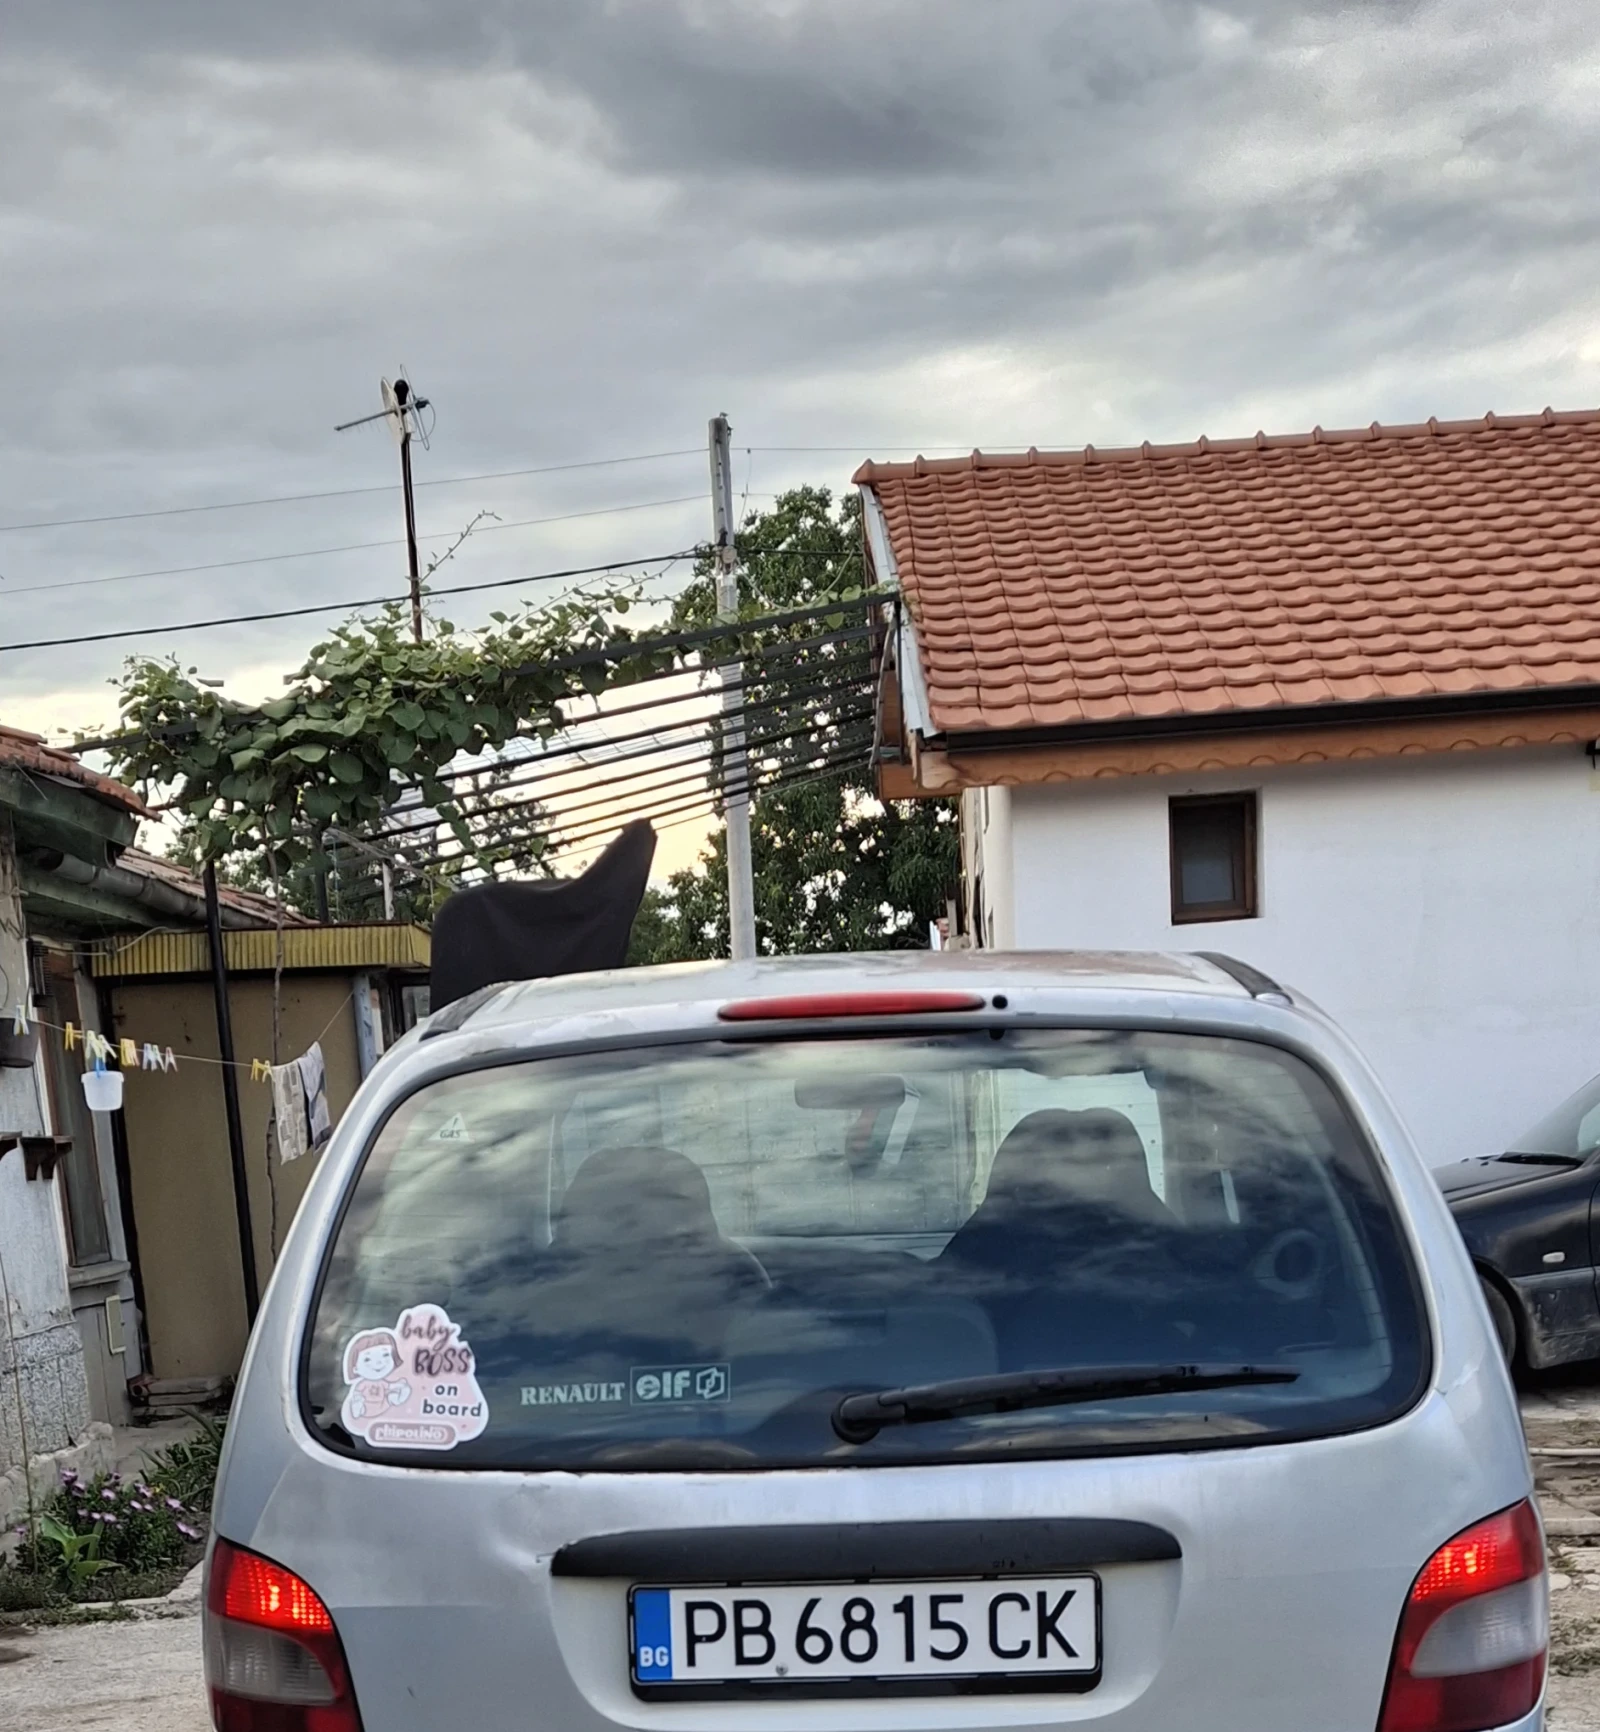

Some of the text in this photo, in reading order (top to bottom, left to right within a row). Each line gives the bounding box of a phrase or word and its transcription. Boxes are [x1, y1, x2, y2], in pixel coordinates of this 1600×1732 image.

[401, 1313, 456, 1351] baby
[414, 1347, 472, 1376] BOSS
[435, 1384, 458, 1396] on
[520, 1370, 691, 1405] RENAULT elf
[422, 1399, 482, 1417] board
[684, 1589, 1080, 1668] PB 6815 CK
[639, 1647, 669, 1668] BG
